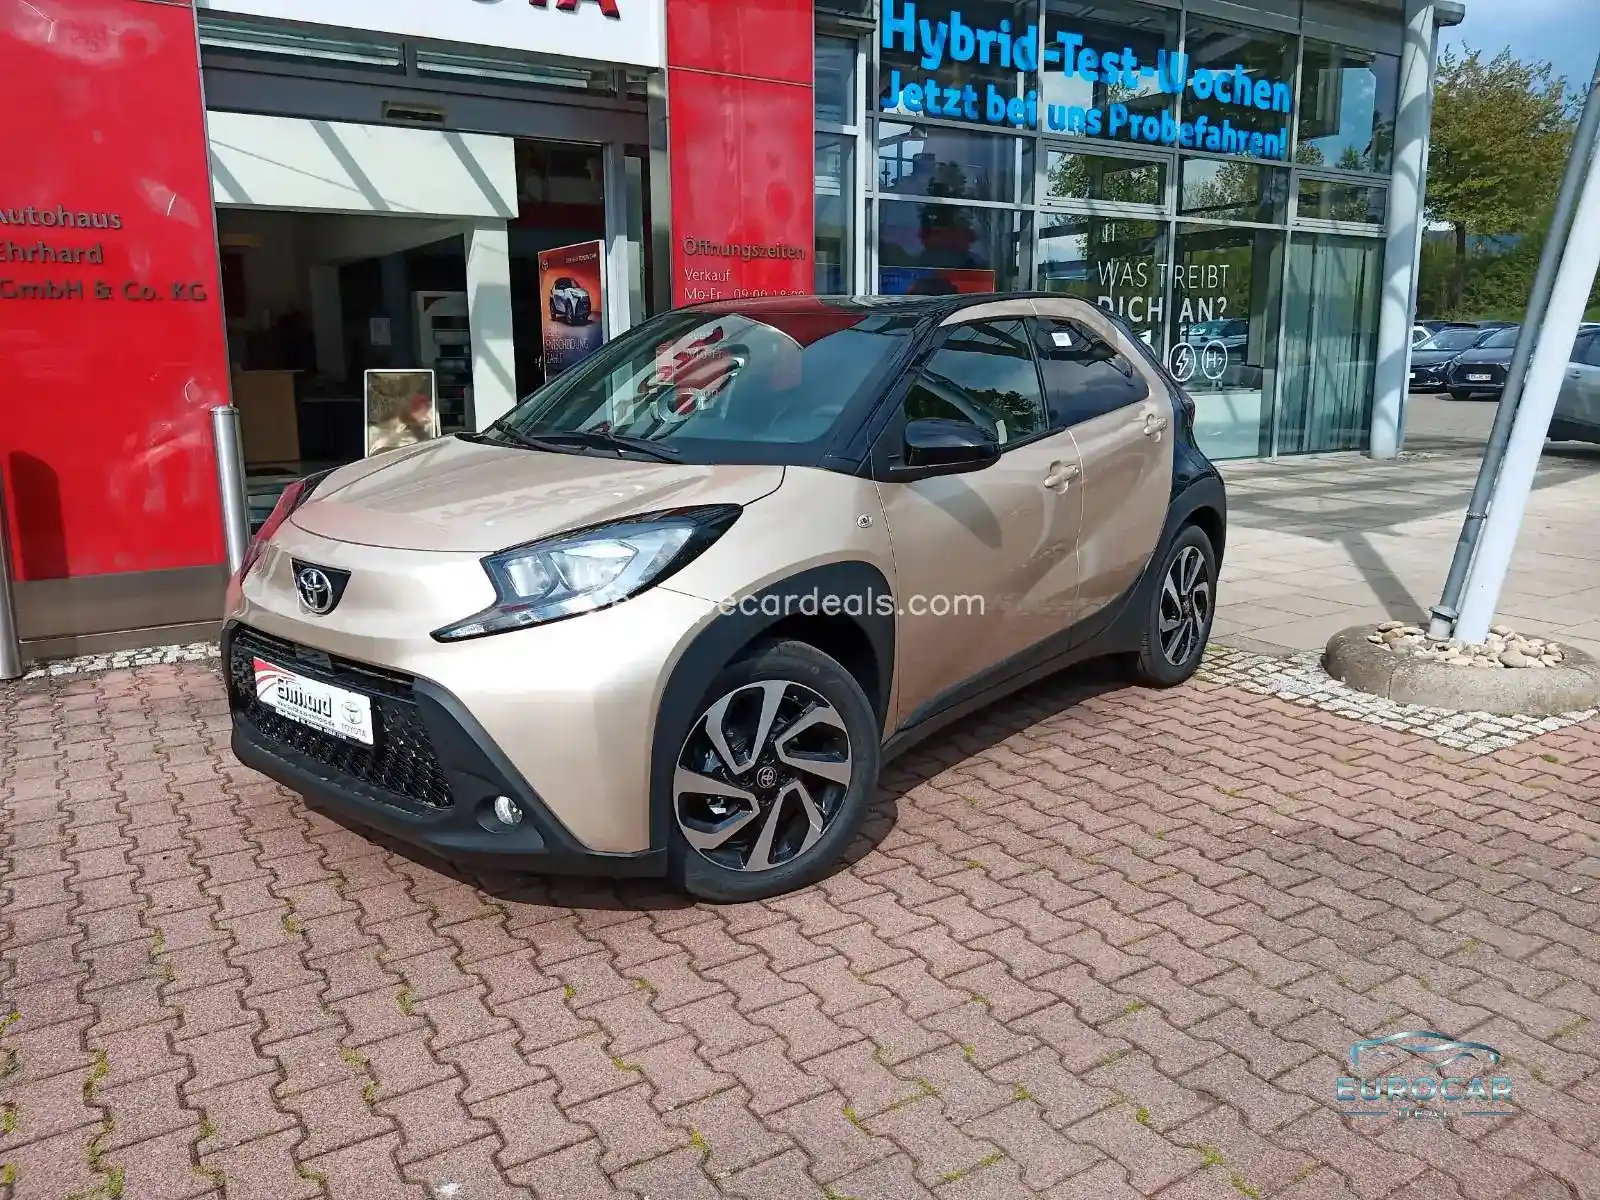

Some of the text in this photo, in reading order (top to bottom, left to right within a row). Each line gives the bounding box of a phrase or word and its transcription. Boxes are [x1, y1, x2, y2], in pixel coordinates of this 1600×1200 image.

[882, 0, 1291, 113] Hybrid-Test-Wochen
[880, 70, 1287, 160] Jetzt bei uns Probefahren!
[683, 235, 806, 262] Öffnungszeiten
[684, 267, 731, 282] Verkauf
[1097, 261, 1230, 289] WAS TREIBT
[1, 279, 207, 301] GmbH & Co. KG
[684, 287, 722, 300] Mo-Fr
[1097, 296, 1227, 324] DICH AN?
